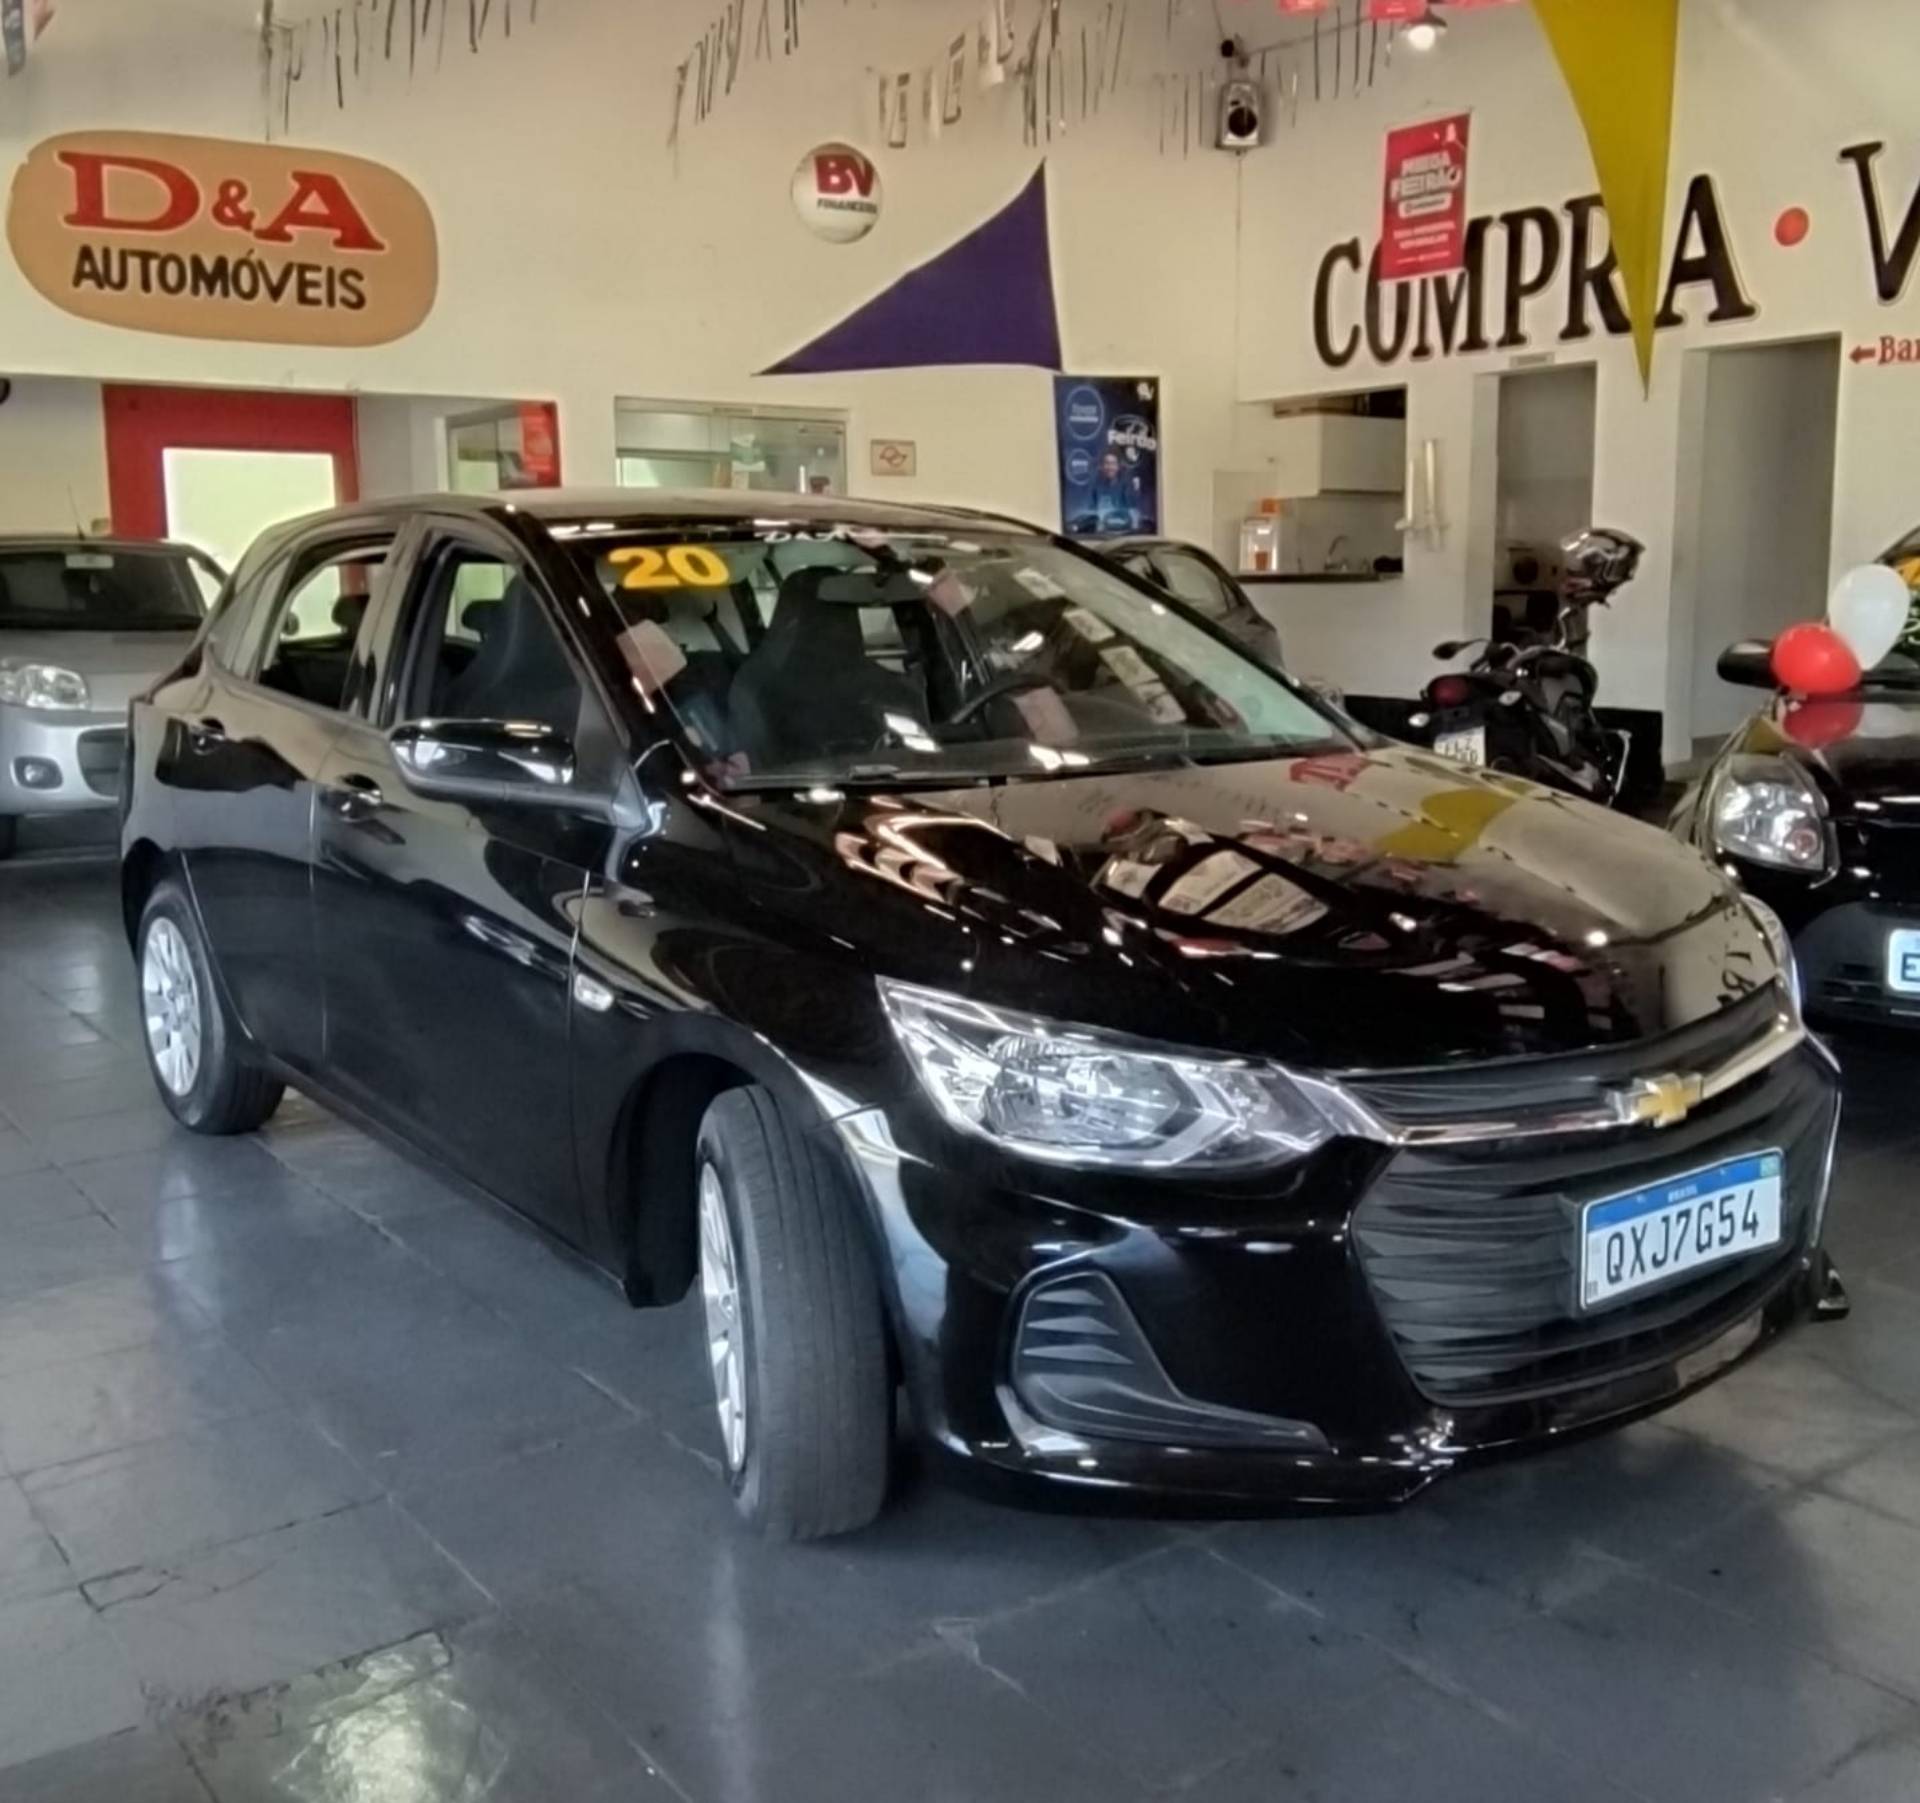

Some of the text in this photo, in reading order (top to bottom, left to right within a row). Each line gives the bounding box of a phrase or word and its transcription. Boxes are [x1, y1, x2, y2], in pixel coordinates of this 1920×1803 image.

[57, 150, 386, 252] D&A
[814, 153, 875, 198] BV
[72, 244, 367, 311] AUTOMÓVEIS
[1313, 173, 1757, 368] COMPRA
[608, 546, 730, 589] 20
[1606, 1188, 1759, 1286] QXJ7G54
